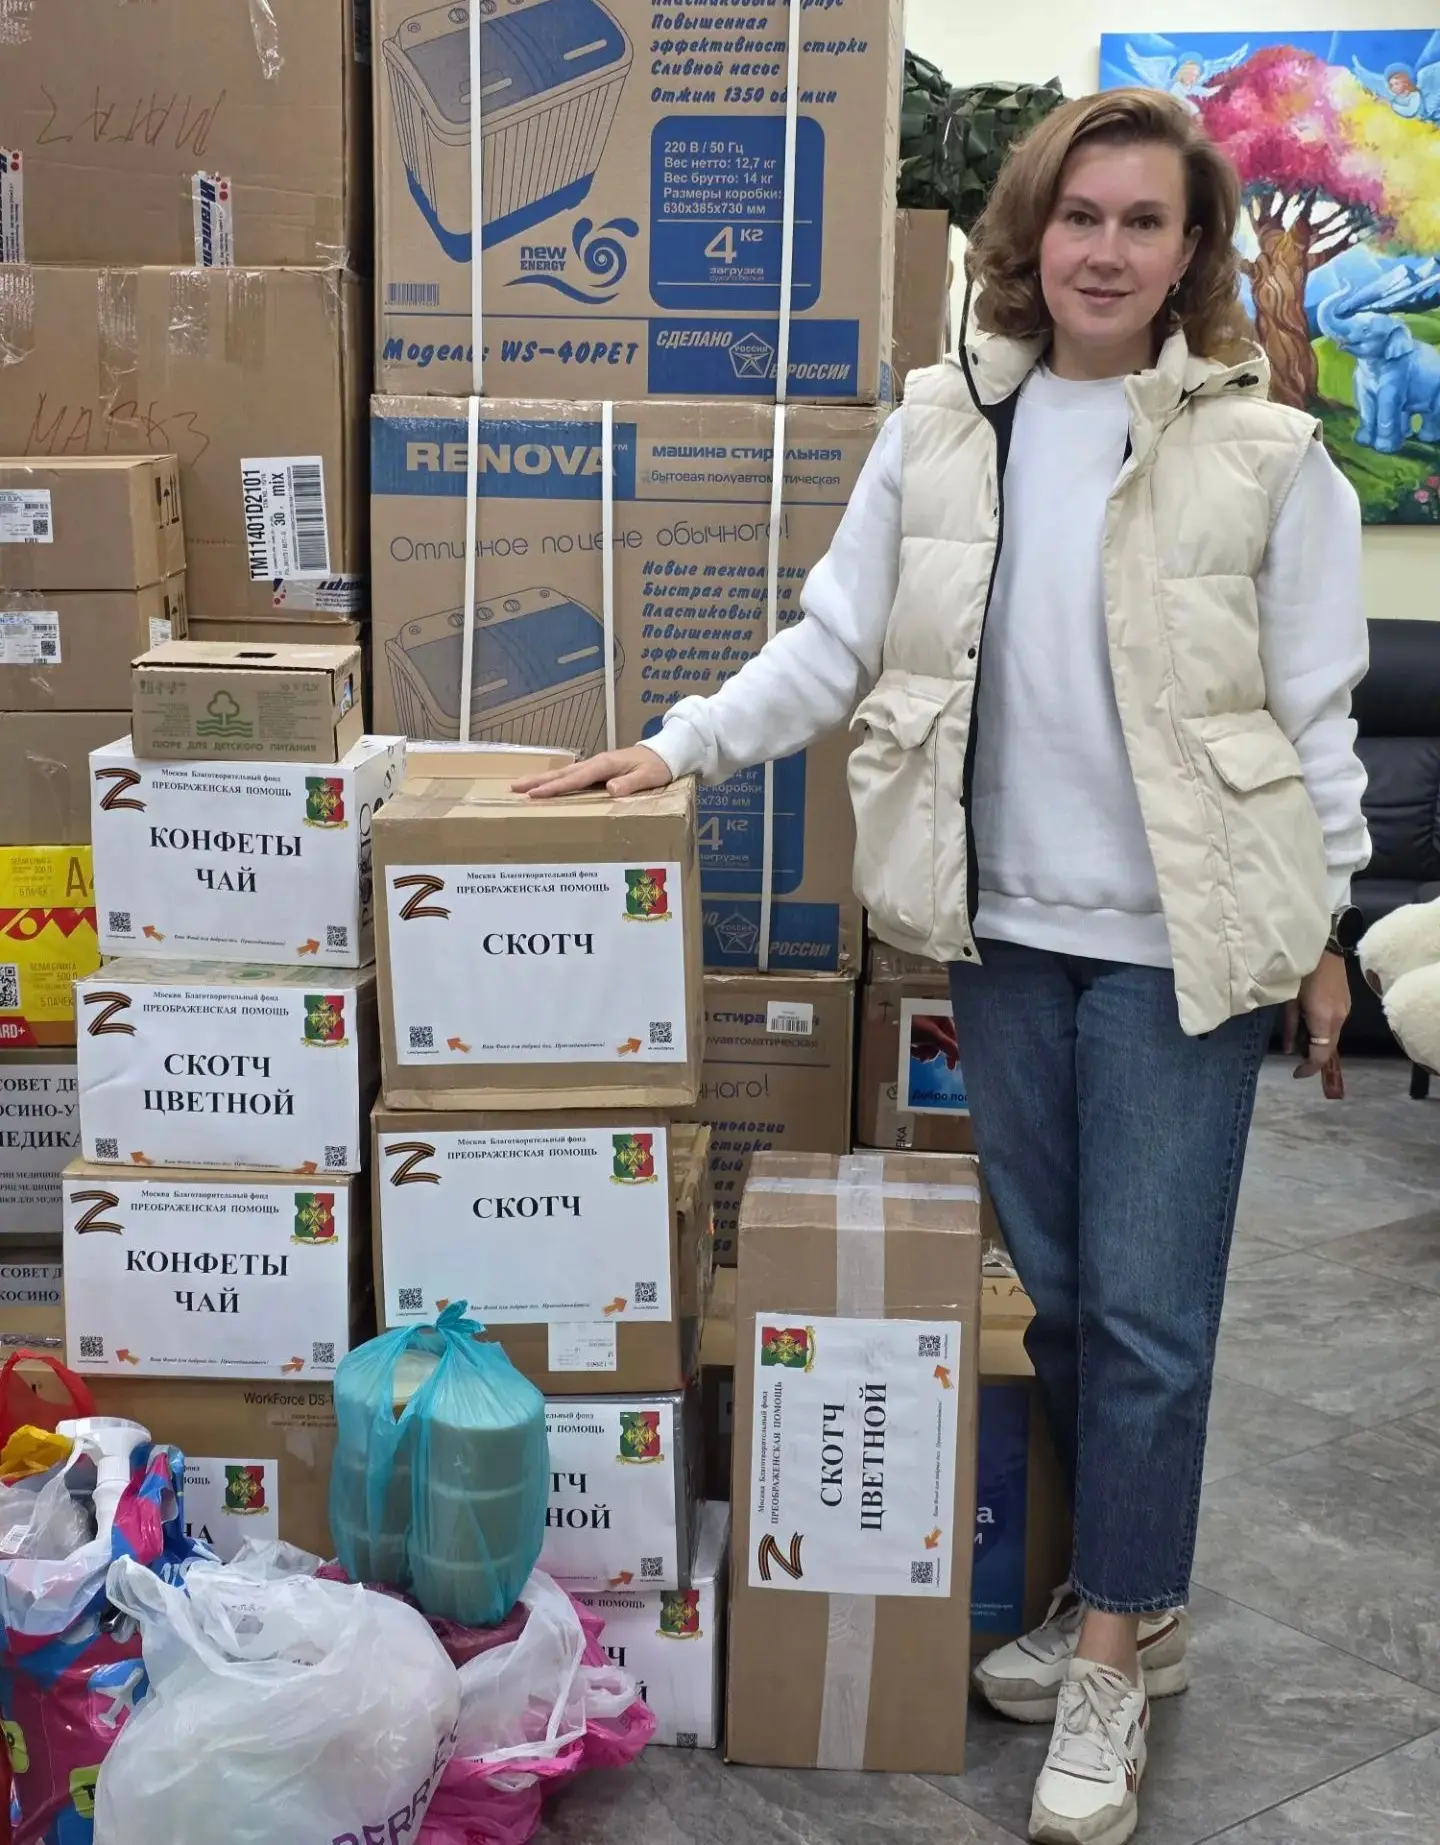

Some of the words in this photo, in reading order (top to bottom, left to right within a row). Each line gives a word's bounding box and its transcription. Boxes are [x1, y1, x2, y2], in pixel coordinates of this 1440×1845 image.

[651, 12, 768, 30] Повышенная
[650, 36, 789, 55] эффективност
[802, 37, 868, 56] стирки
[651, 58, 724, 76] Сливной
[729, 64, 780, 76] насос
[650, 86, 716, 103] Отжим
[723, 86, 765, 103] 1350
[769, 86, 837, 104] обмин
[664, 142, 687, 153] 220
[690, 142, 699, 153] В
[710, 142, 724, 153] 50
[728, 142, 744, 155] Гц
[664, 157, 688, 169] Вес
[692, 159, 732, 169] нетто:
[735, 157, 760, 171] 12,7
[763, 160, 776, 170] кг
[663, 172, 688, 185] Вес
[691, 171, 740, 188] брутто:
[743, 172, 758, 185] 14
[760, 174, 774, 185] кг
[663, 187, 722, 202] Размеры
[725, 186, 783, 202] коробки:
[746, 204, 767, 215] мм
[520, 246, 567, 260] new
[704, 226, 738, 264] 4
[520, 259, 566, 272] ENERGY
[709, 266, 765, 278] загрузка
[656, 330, 733, 349] СДЕЛАНО
[382, 337, 490, 368] Модел:
[501, 339, 640, 366] WS-40PET
[734, 344, 769, 354] РОССИЯ
[787, 363, 851, 381] РОССИИ
[406, 441, 617, 477] RENOVA
[652, 445, 728, 459] машина
[730, 446, 842, 461] стирльная
[268, 472, 286, 497] mix
[651, 469, 705, 483] бытовая
[707, 472, 840, 486] полуавтомтическая
[242, 469, 269, 580] TM11401D2101
[273, 512, 286, 526] 30
[542, 534, 574, 554] по
[642, 559, 698, 577] Новые
[703, 564, 806, 579] технолгии
[642, 581, 723, 601] Быстрая
[727, 585, 793, 602] стира
[642, 602, 763, 621] Пластиковый
[642, 623, 753, 641] Повышенная
[641, 645, 761, 663] эффективнос
[641, 664, 712, 682] Сливной
[641, 690, 684, 705] Отж
[152, 740, 183, 751] ПЮРЕ
[186, 741, 209, 752] ДЛЯ
[213, 742, 265, 753] ДЕТСКОГО
[269, 743, 317, 754] ПИТАНИЯ
[152, 781, 242, 794] ПРЕОБРАЖЕНСКАЯ
[246, 786, 292, 798] ПОМОЩЬ
[149, 826, 302, 857] КОНФЕТЫ
[698, 816, 724, 851] 4
[196, 866, 258, 893] ЧАЙ
[456, 883, 556, 895] ПРЕОБРАЖЕНСКАЯ
[559, 882, 610, 894] ПОМОЩЬ
[482, 932, 596, 956] СКОТЧ
[769, 941, 831, 958] РОССИИ
[143, 1003, 237, 1015] ПРЕОБРАЖЕНСКАЯ
[241, 1006, 290, 1017] ПОМОЩЬ
[705, 1036, 819, 1049] луавтоматическая
[164, 1053, 272, 1079] СКОТЧ
[0, 1104, 79, 1118] СИНО-У
[143, 1088, 295, 1116] ЦВЕТНОЙ
[0, 1131, 82, 1152] ЕДИКА
[710, 1139, 772, 1155] стирка
[447, 1149, 545, 1160] ПРЕОБРАЖЕНСКАЯ
[548, 1147, 598, 1158] ПОМОЩЬ
[130, 1202, 227, 1213] ПРЕОБРАЖЕНСКАЯ
[231, 1203, 280, 1215] ПОМОЩЬ
[472, 1195, 583, 1219] СКОТЧ
[125, 1250, 290, 1277] КОНФЕТЫ
[0, 1267, 50, 1279] СОВЕТ
[52, 1267, 63, 1280] Д
[174, 1287, 241, 1314] ЧАЙ
[243, 1391, 305, 1406] WorkForce
[308, 1392, 335, 1407] DS-1
[773, 1381, 783, 1428] ПОМОЩЬ
[575, 1412, 595, 1421] фонд
[557, 1424, 605, 1434] ПОМОЩЬ
[820, 1402, 845, 1507] СКОТЧ
[858, 1381, 887, 1532] ЦВЕТНОЙ
[770, 1431, 781, 1525] ПРЕОБРАЖЕНСКАЯ
[598, 1598, 646, 1610] ПОМОЩЬ
